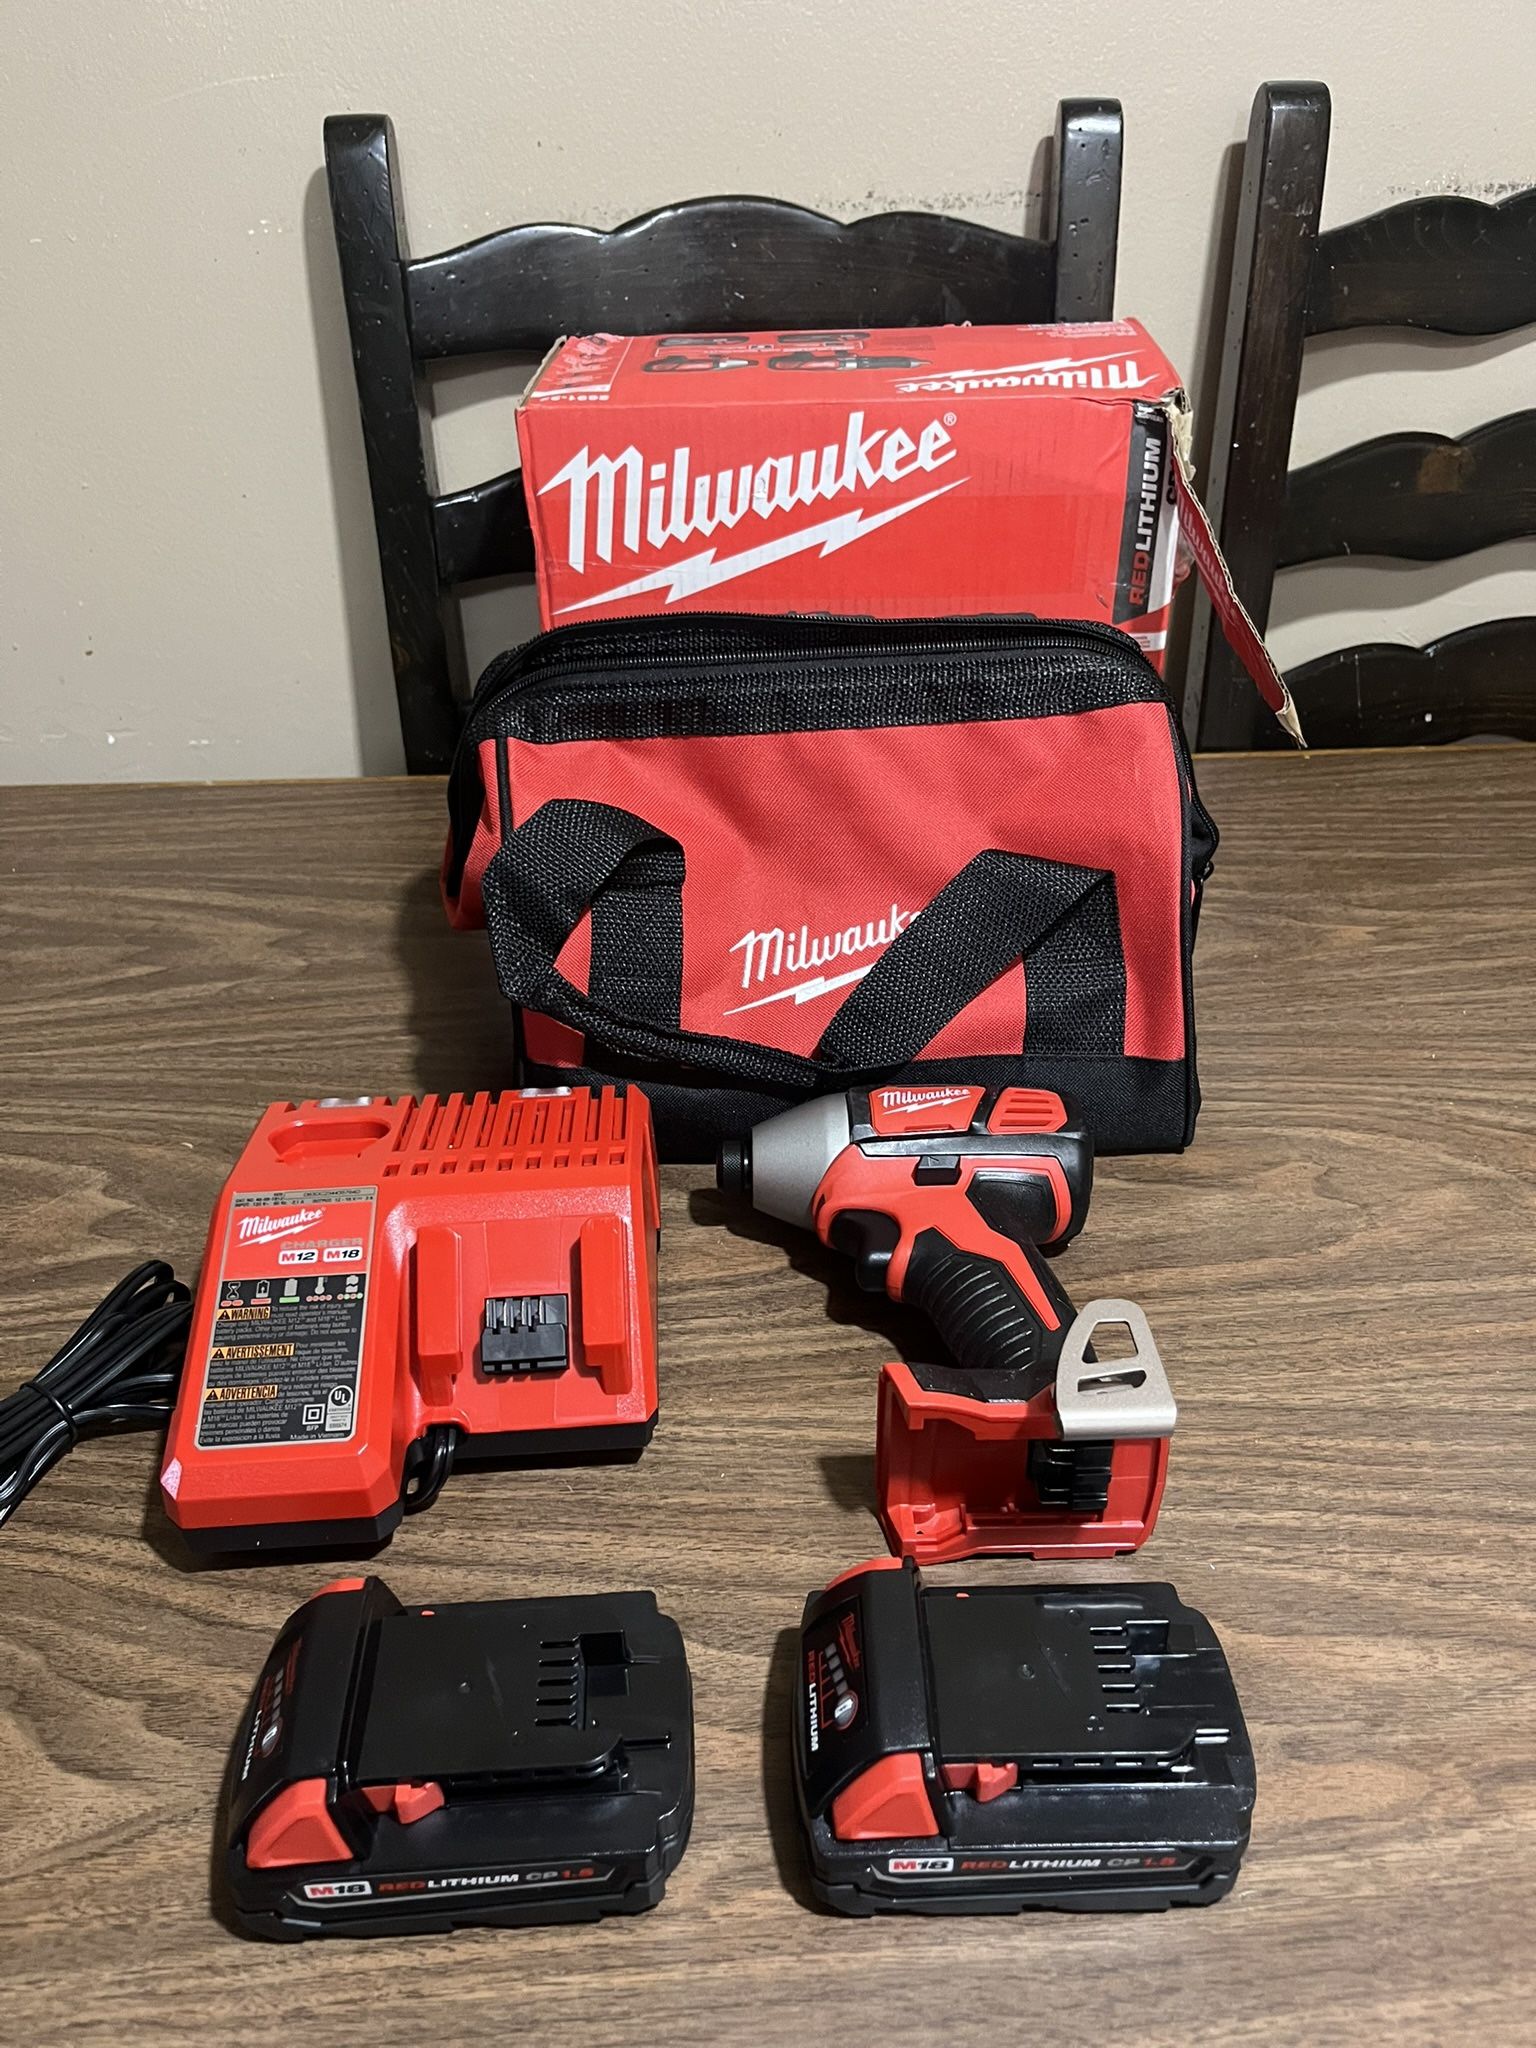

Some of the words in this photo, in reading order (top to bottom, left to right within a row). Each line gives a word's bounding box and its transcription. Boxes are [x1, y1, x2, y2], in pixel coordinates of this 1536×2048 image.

[895, 360, 1160, 394] Milwaukee
[1129, 437, 1161, 606] REDLITHIUM
[729, 904, 921, 989] Milwauk
[879, 1088, 970, 1108] Milwaukee
[237, 1207, 323, 1239] Milwaukee
[281, 1238, 363, 1249] CHARGER
[282, 1251, 316, 1262] M12
[327, 1249, 360, 1260] M18
[230, 1308, 269, 1319] WARNING
[225, 1345, 292, 1357] AVERTISSEMENT
[219, 1386, 276, 1399] ADVERTENCIA
[894, 1860, 950, 1871] M18
[960, 1858, 1101, 1870] REDLITHIUM
[310, 1883, 367, 1896] M18
[379, 1873, 520, 1892] REDLITHIUM
